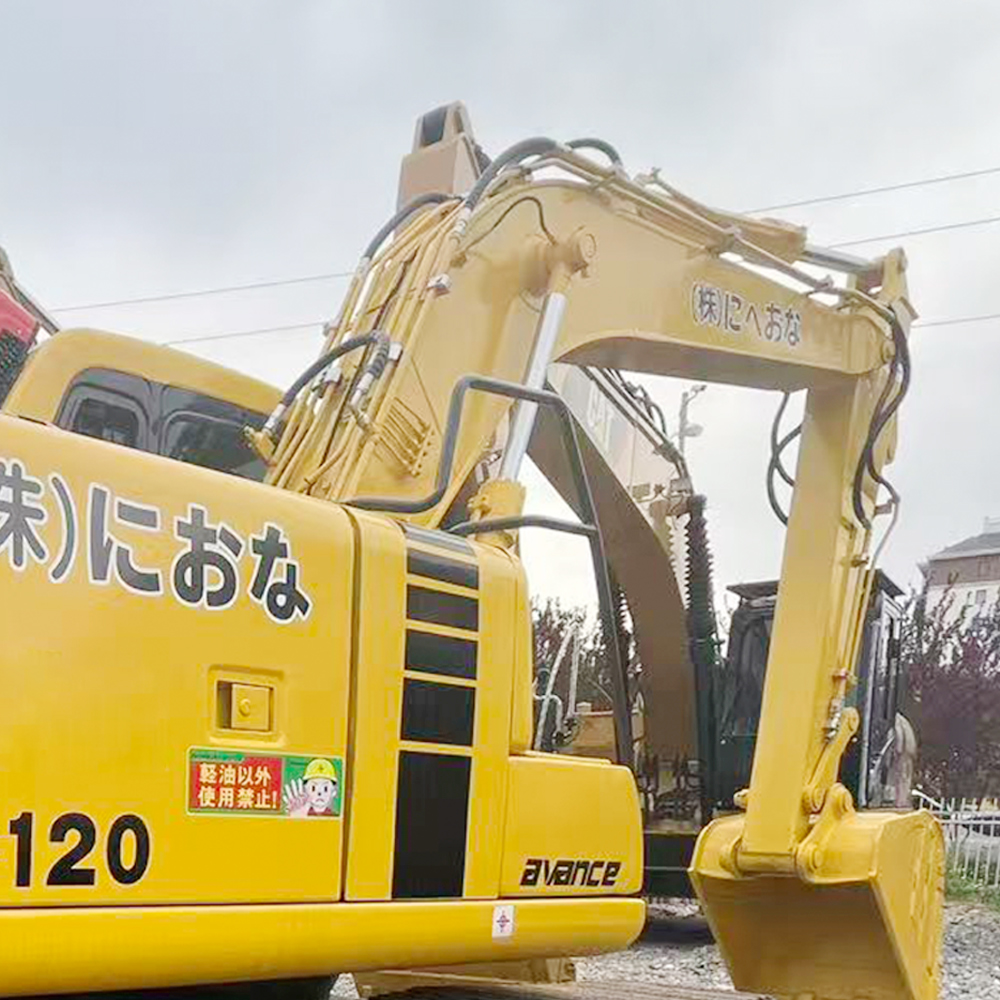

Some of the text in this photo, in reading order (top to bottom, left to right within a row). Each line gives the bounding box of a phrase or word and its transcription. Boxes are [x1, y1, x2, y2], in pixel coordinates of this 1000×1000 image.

[199, 763, 272, 787] 軽油以外
[520, 858, 621, 886] avance
